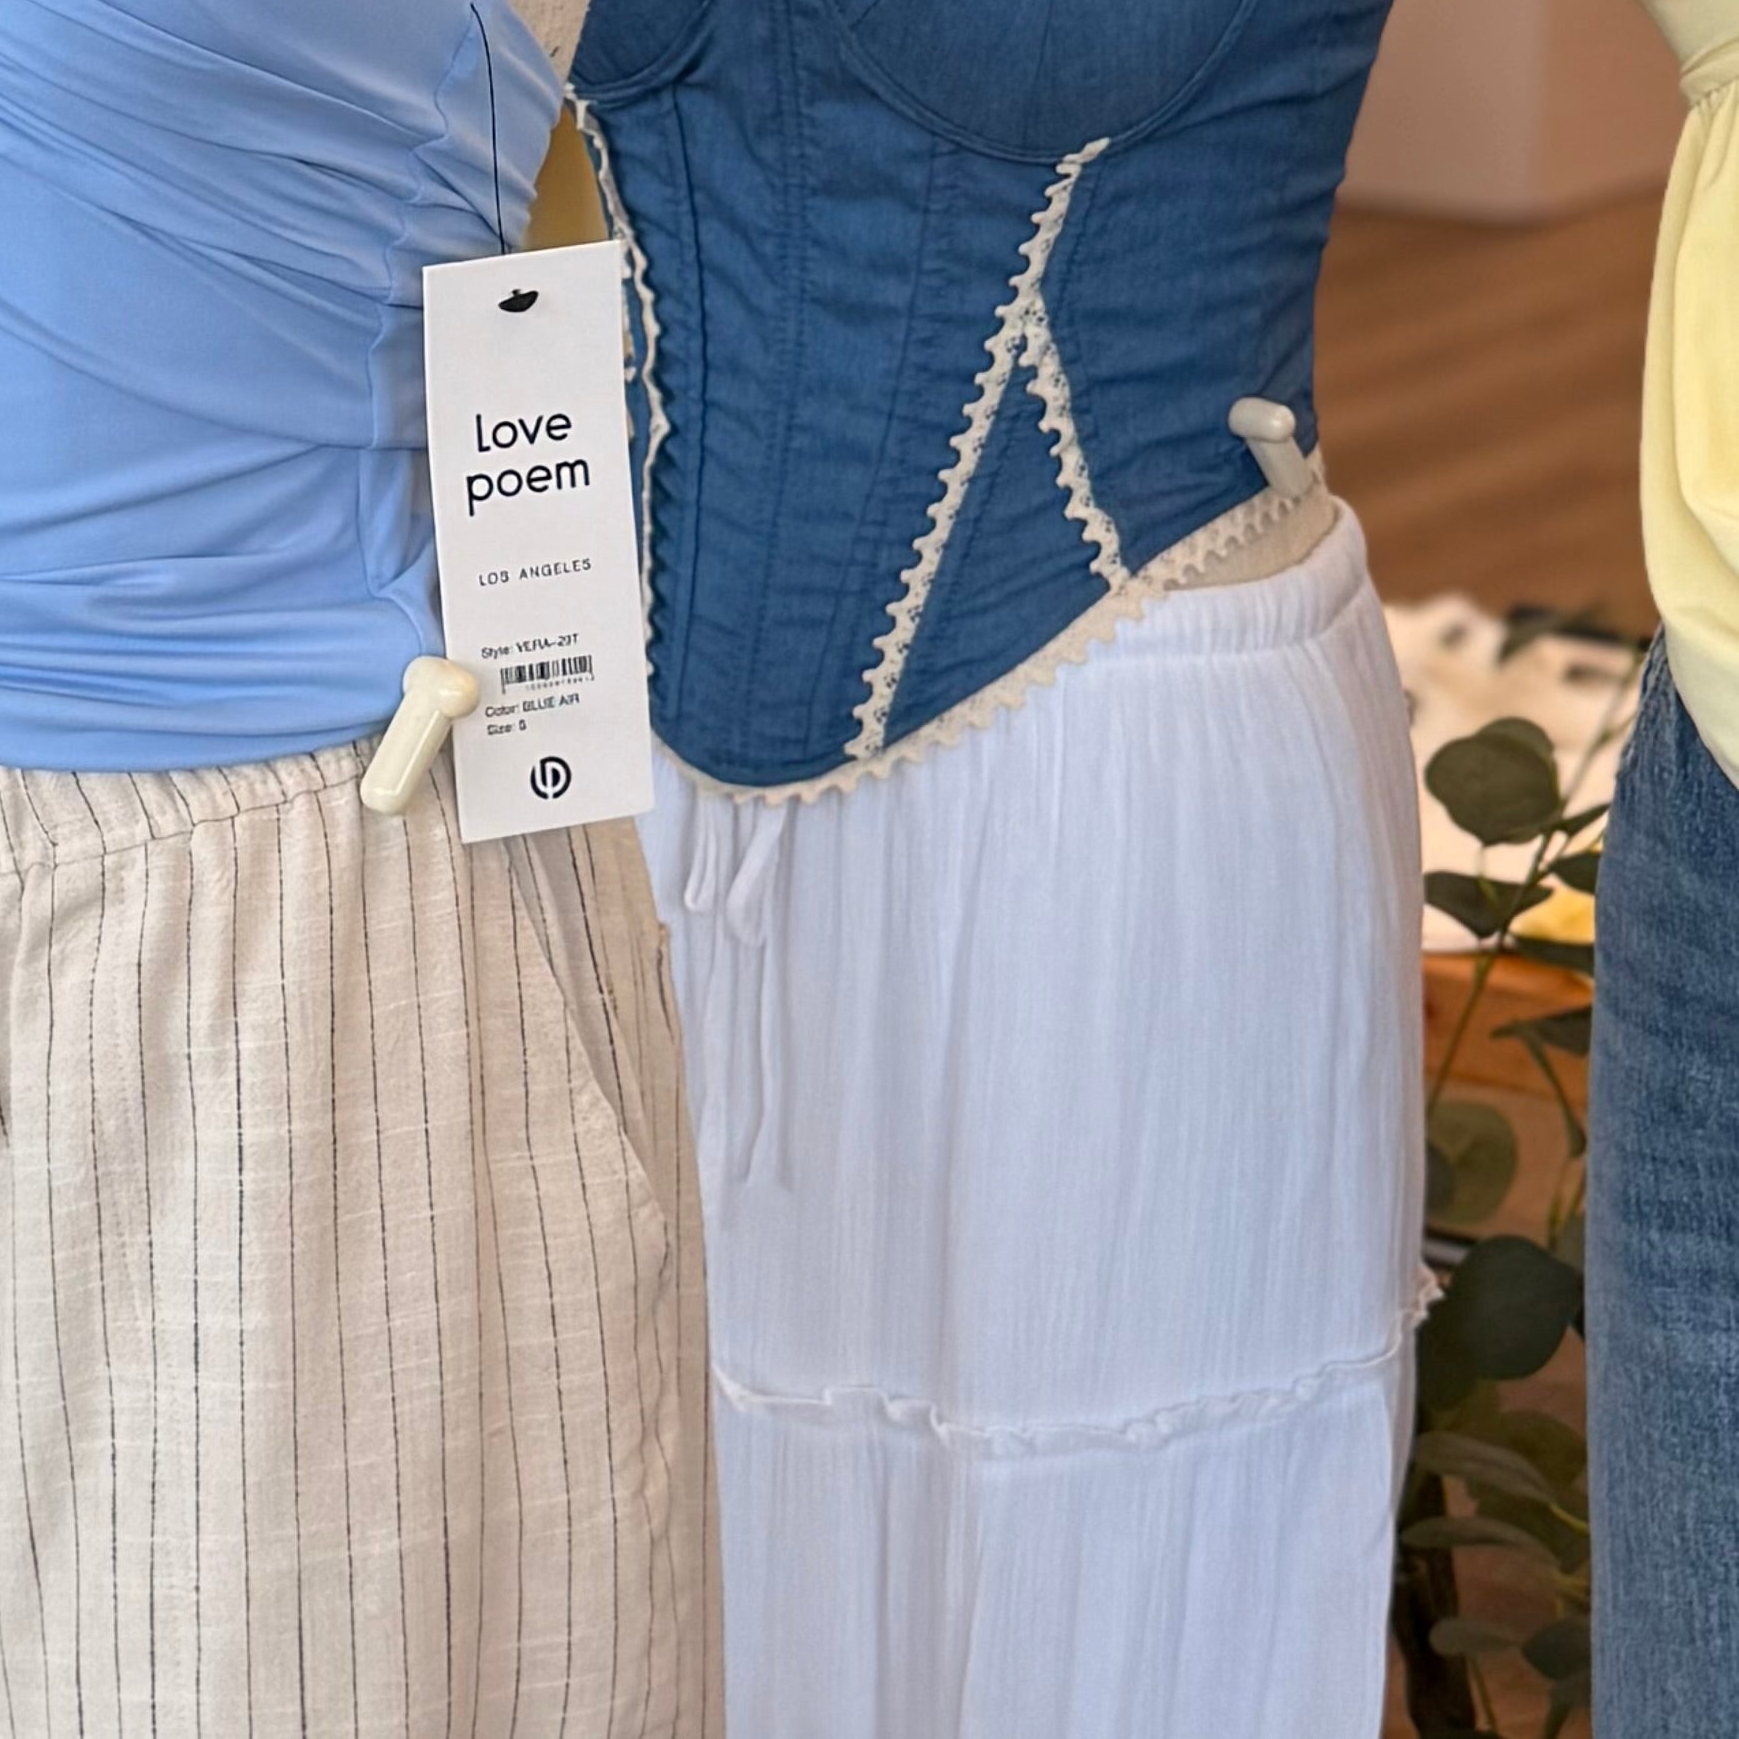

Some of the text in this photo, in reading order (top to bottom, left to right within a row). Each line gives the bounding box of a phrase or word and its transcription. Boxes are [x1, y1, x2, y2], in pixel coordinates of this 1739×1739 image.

[466, 459, 590, 517] poem
[478, 558, 592, 587] LOS ANGELES
